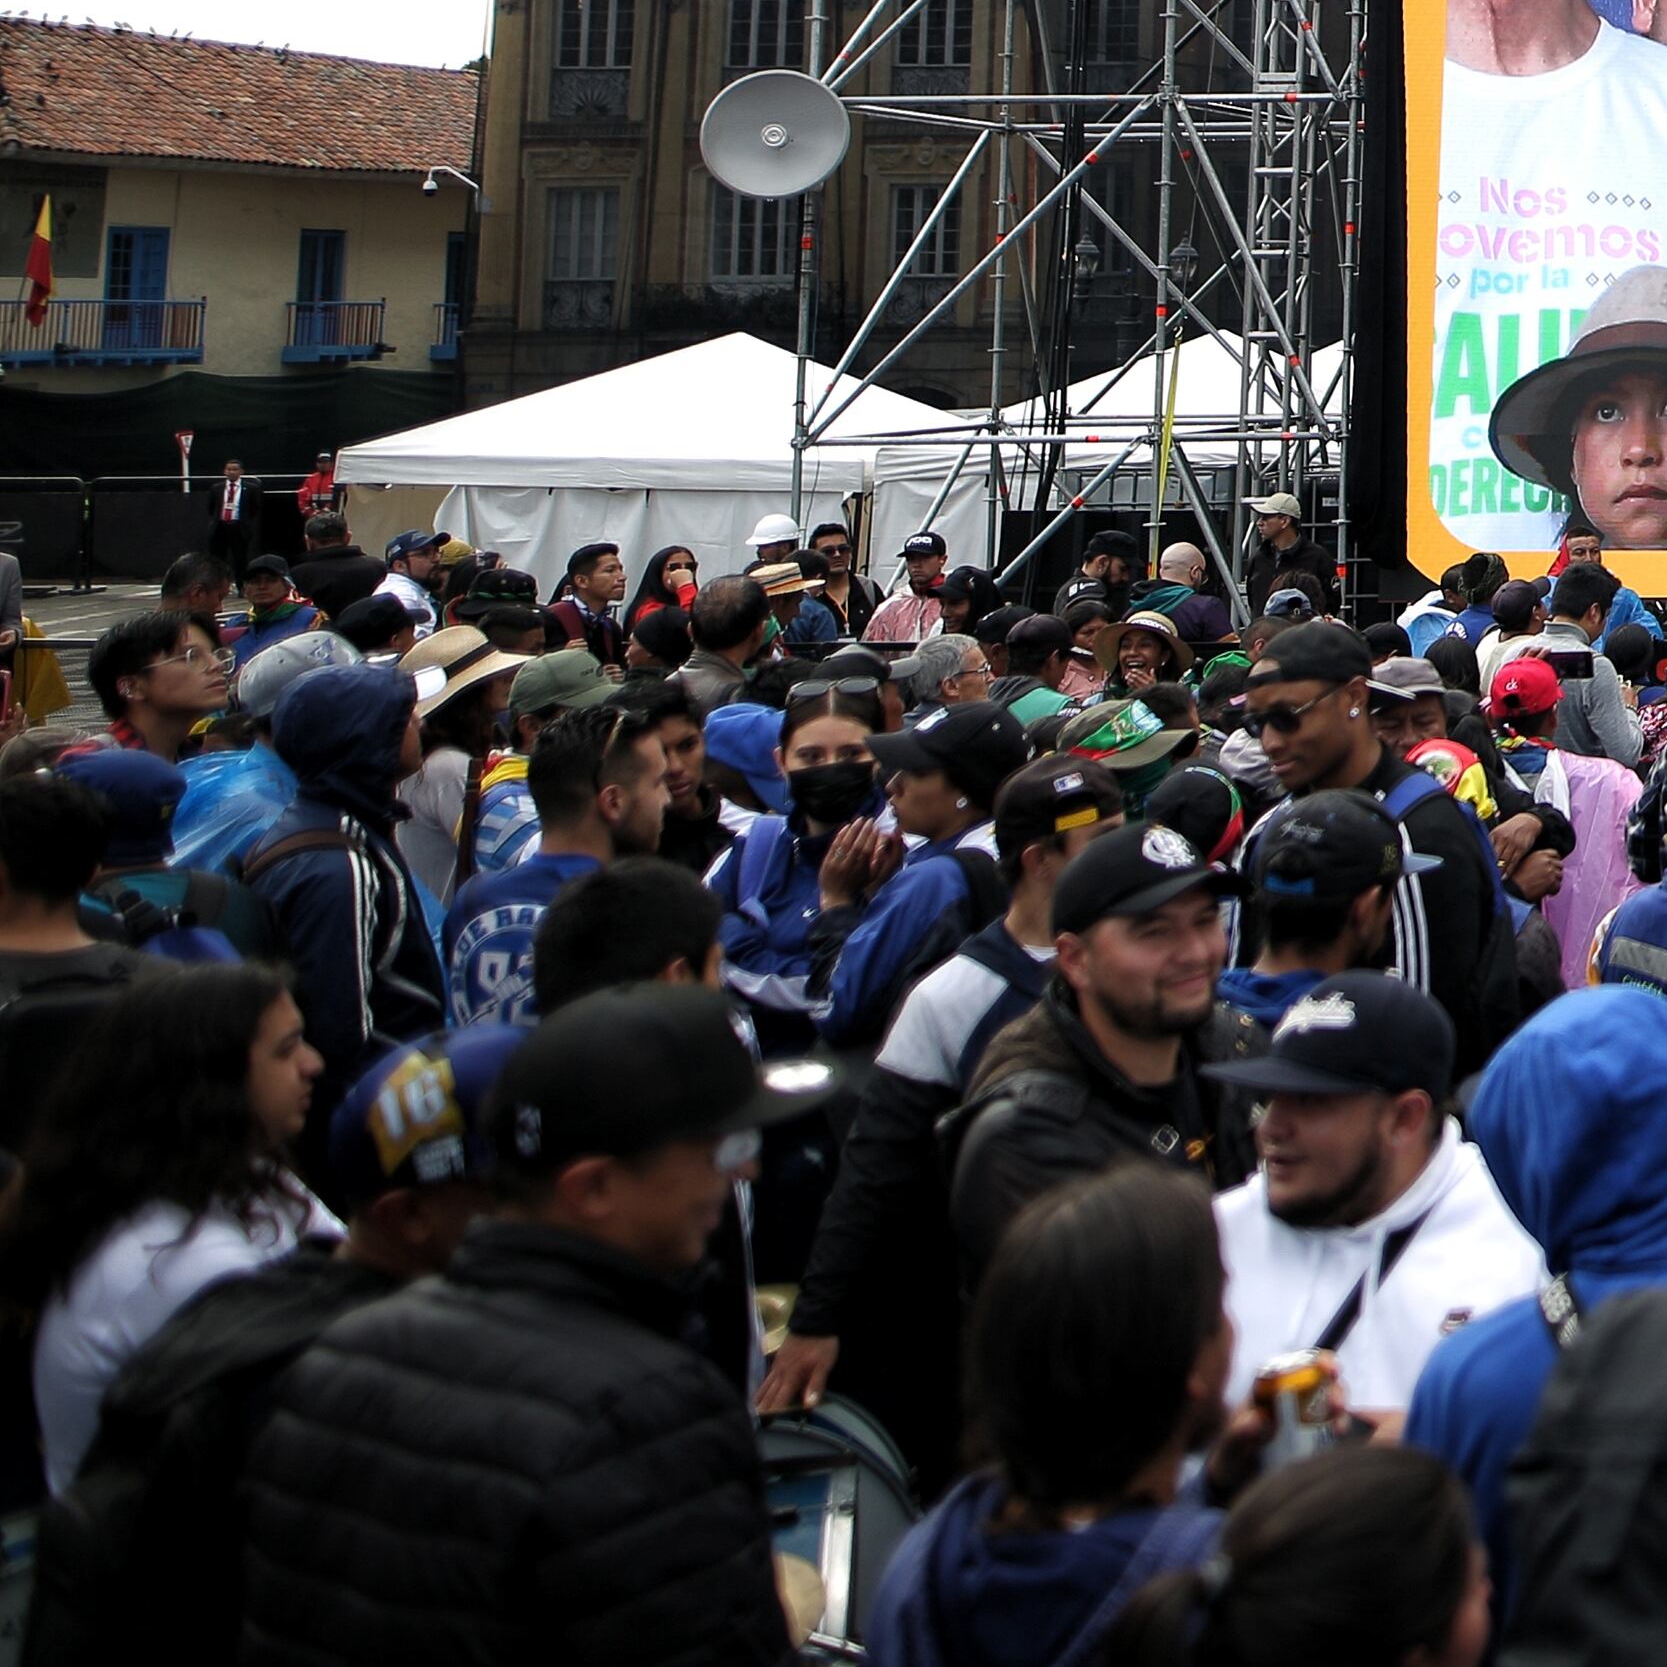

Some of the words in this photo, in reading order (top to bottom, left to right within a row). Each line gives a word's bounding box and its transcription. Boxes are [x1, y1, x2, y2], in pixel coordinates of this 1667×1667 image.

[1480, 176, 1567, 218] Nos
[1439, 223, 1661, 263] ovemos
[1469, 267, 1530, 299] por
[1541, 264, 1571, 289] la
